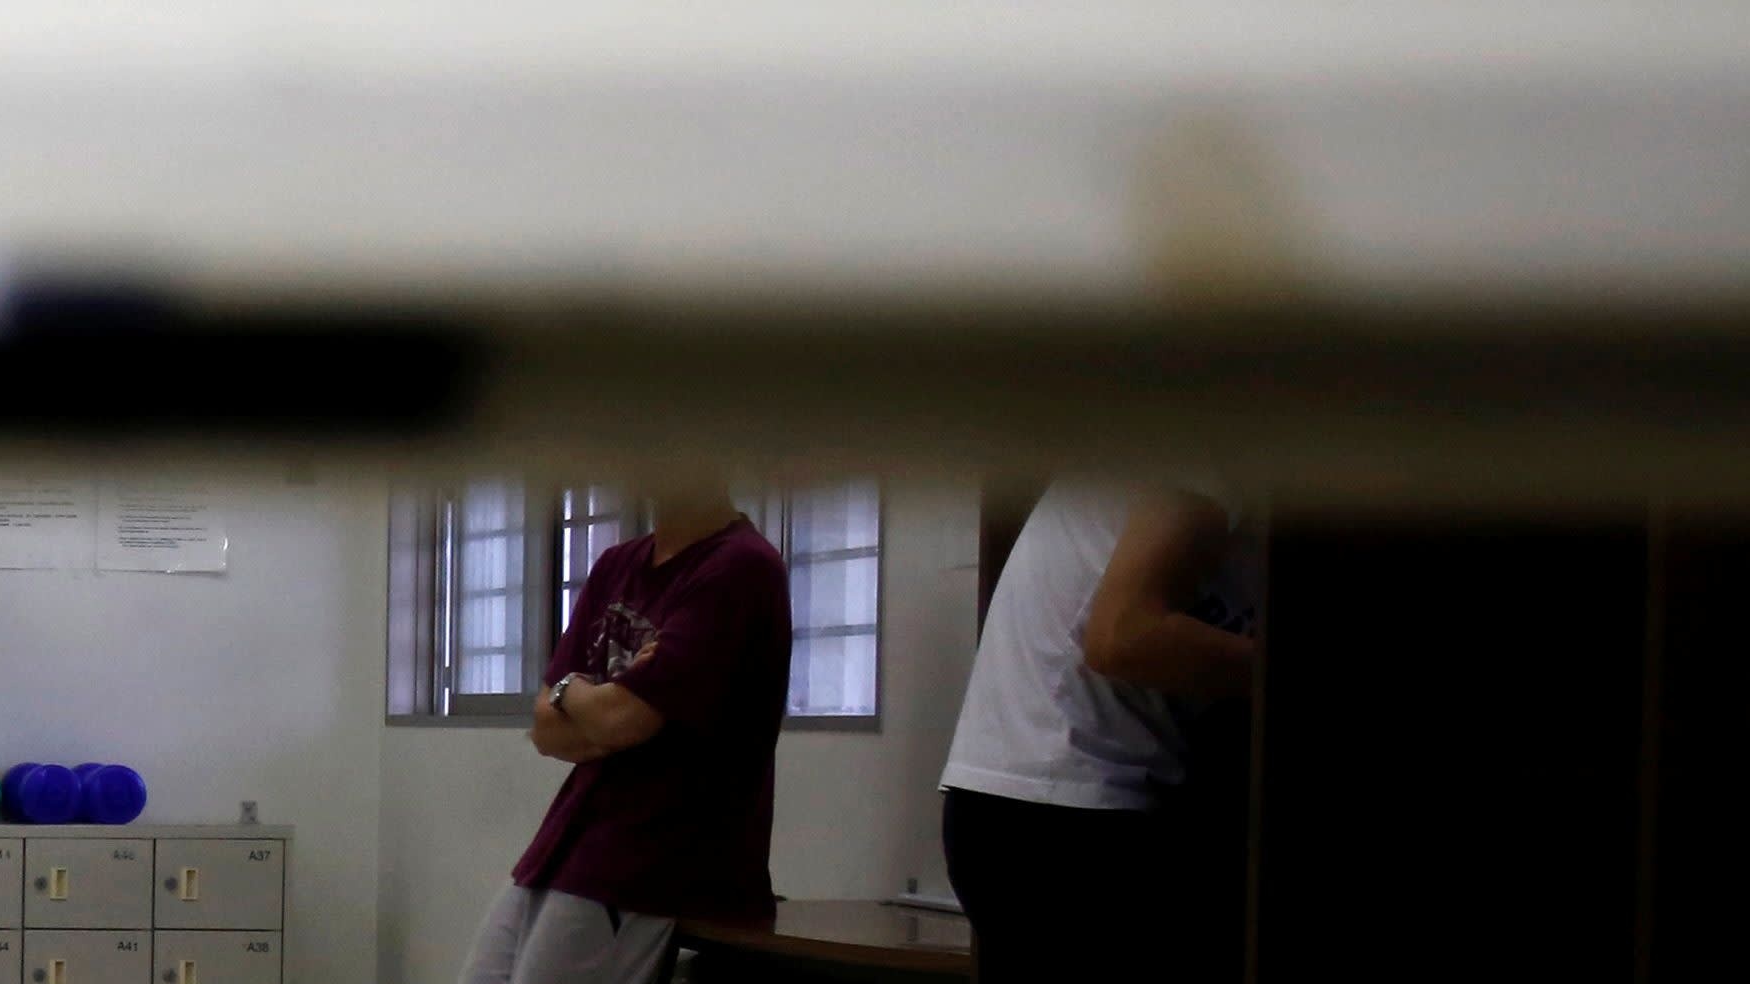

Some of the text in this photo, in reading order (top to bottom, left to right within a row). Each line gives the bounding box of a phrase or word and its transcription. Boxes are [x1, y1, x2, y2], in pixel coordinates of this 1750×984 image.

[248, 850, 271, 862] A37
[116, 940, 139, 952] A41
[246, 941, 270, 953] A38
